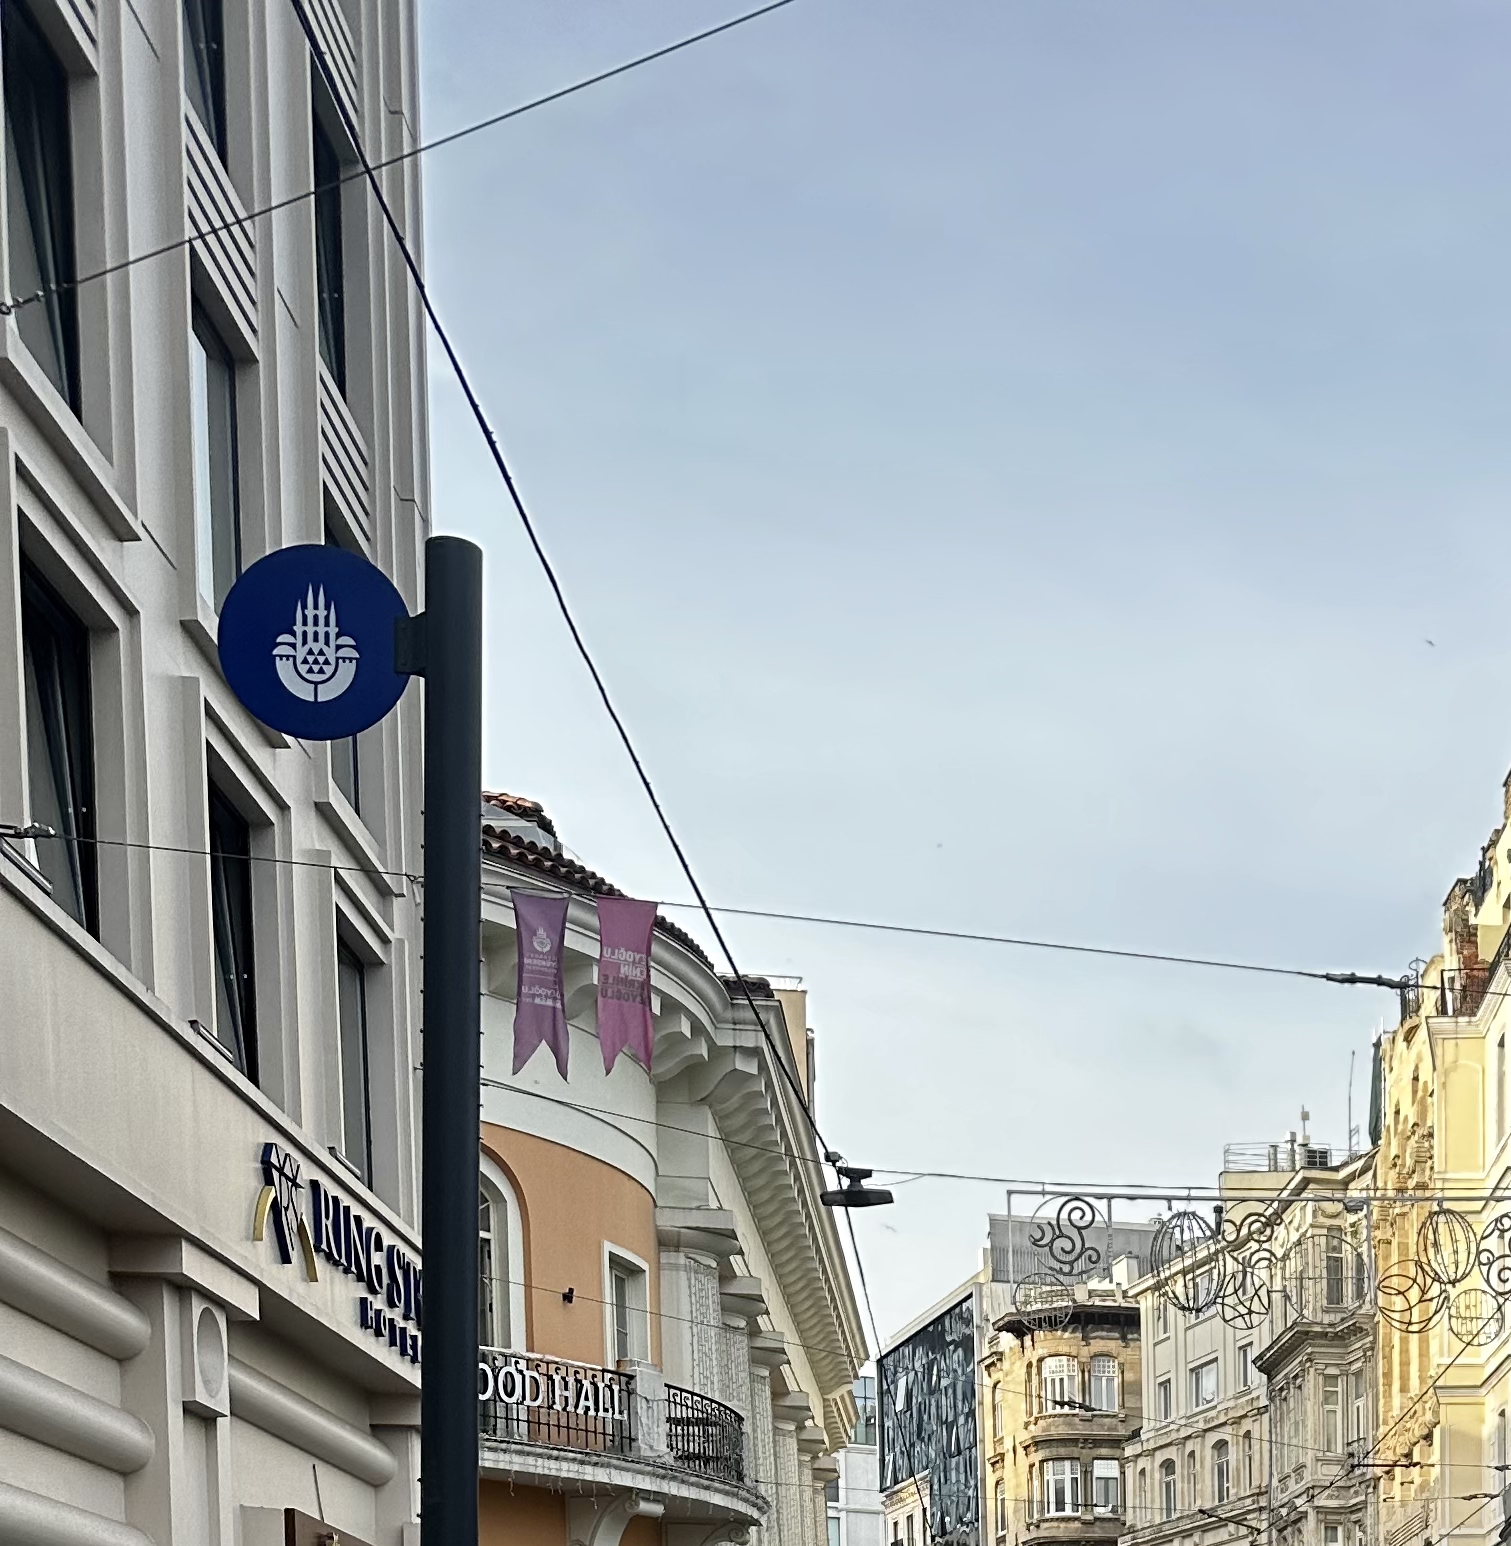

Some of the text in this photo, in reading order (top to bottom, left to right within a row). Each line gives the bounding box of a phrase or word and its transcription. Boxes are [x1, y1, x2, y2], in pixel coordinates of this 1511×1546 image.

[309, 1178, 385, 1296] RING
[478, 1362, 628, 1421] OOD HALL
